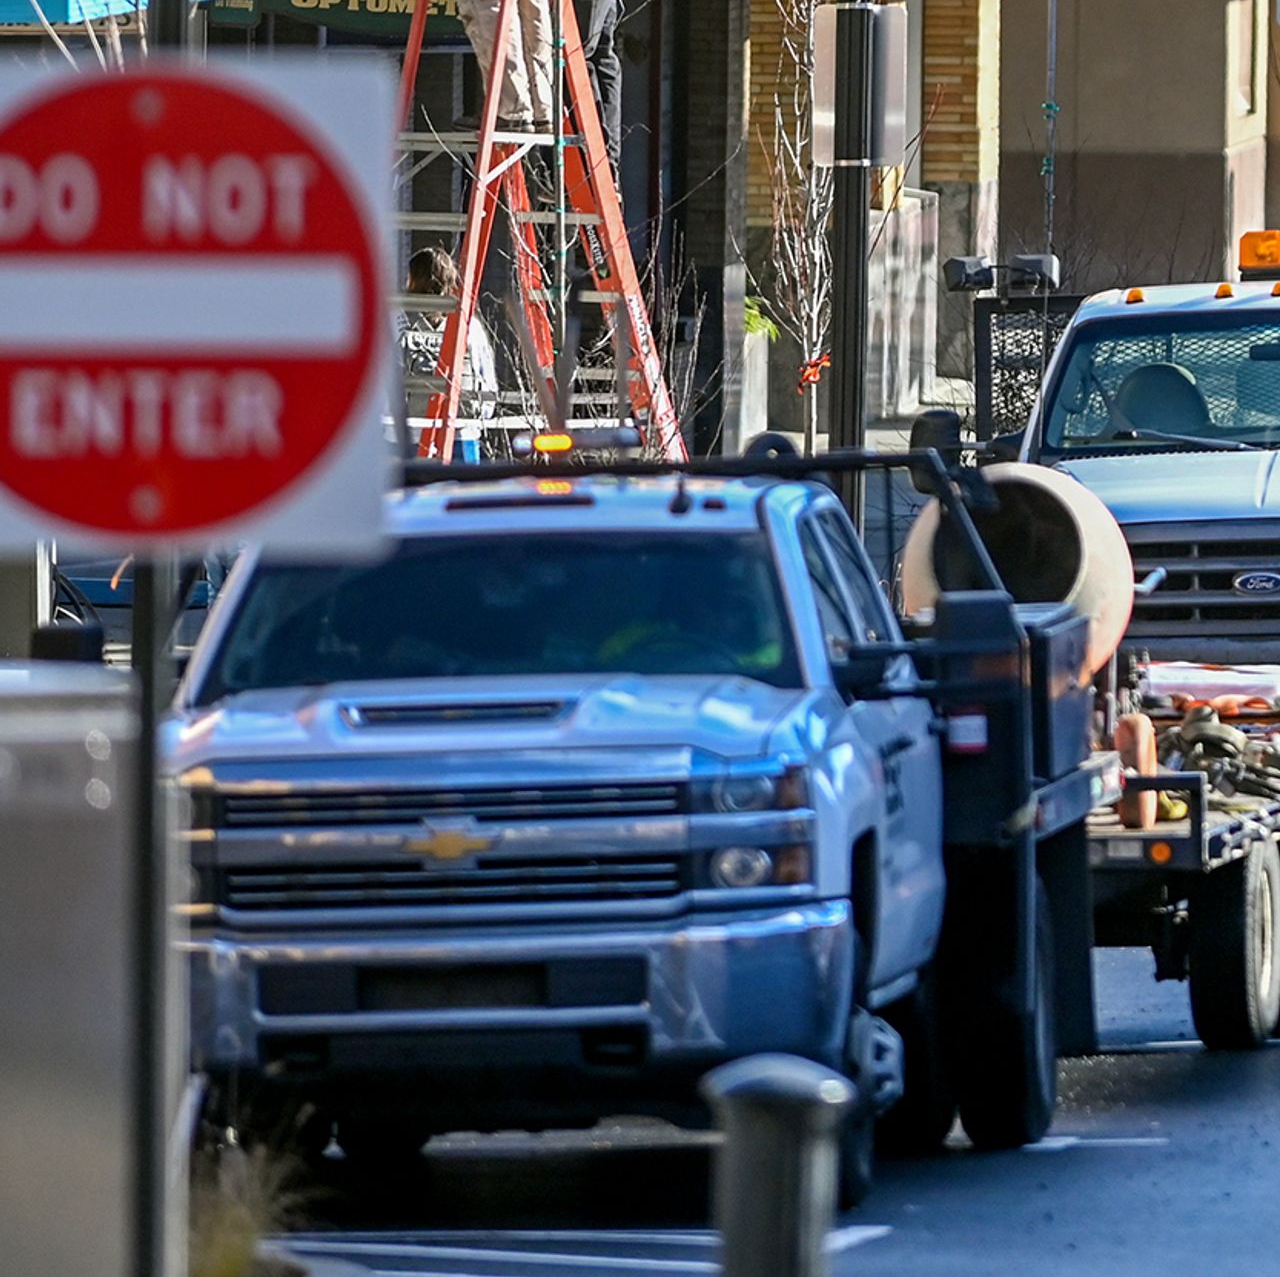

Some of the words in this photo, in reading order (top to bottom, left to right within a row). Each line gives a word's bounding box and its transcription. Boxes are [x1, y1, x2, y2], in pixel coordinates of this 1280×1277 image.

[142, 153, 316, 247] NOT
[10, 368, 286, 461] ENTER
[1246, 576, 1276, 590] Ford
